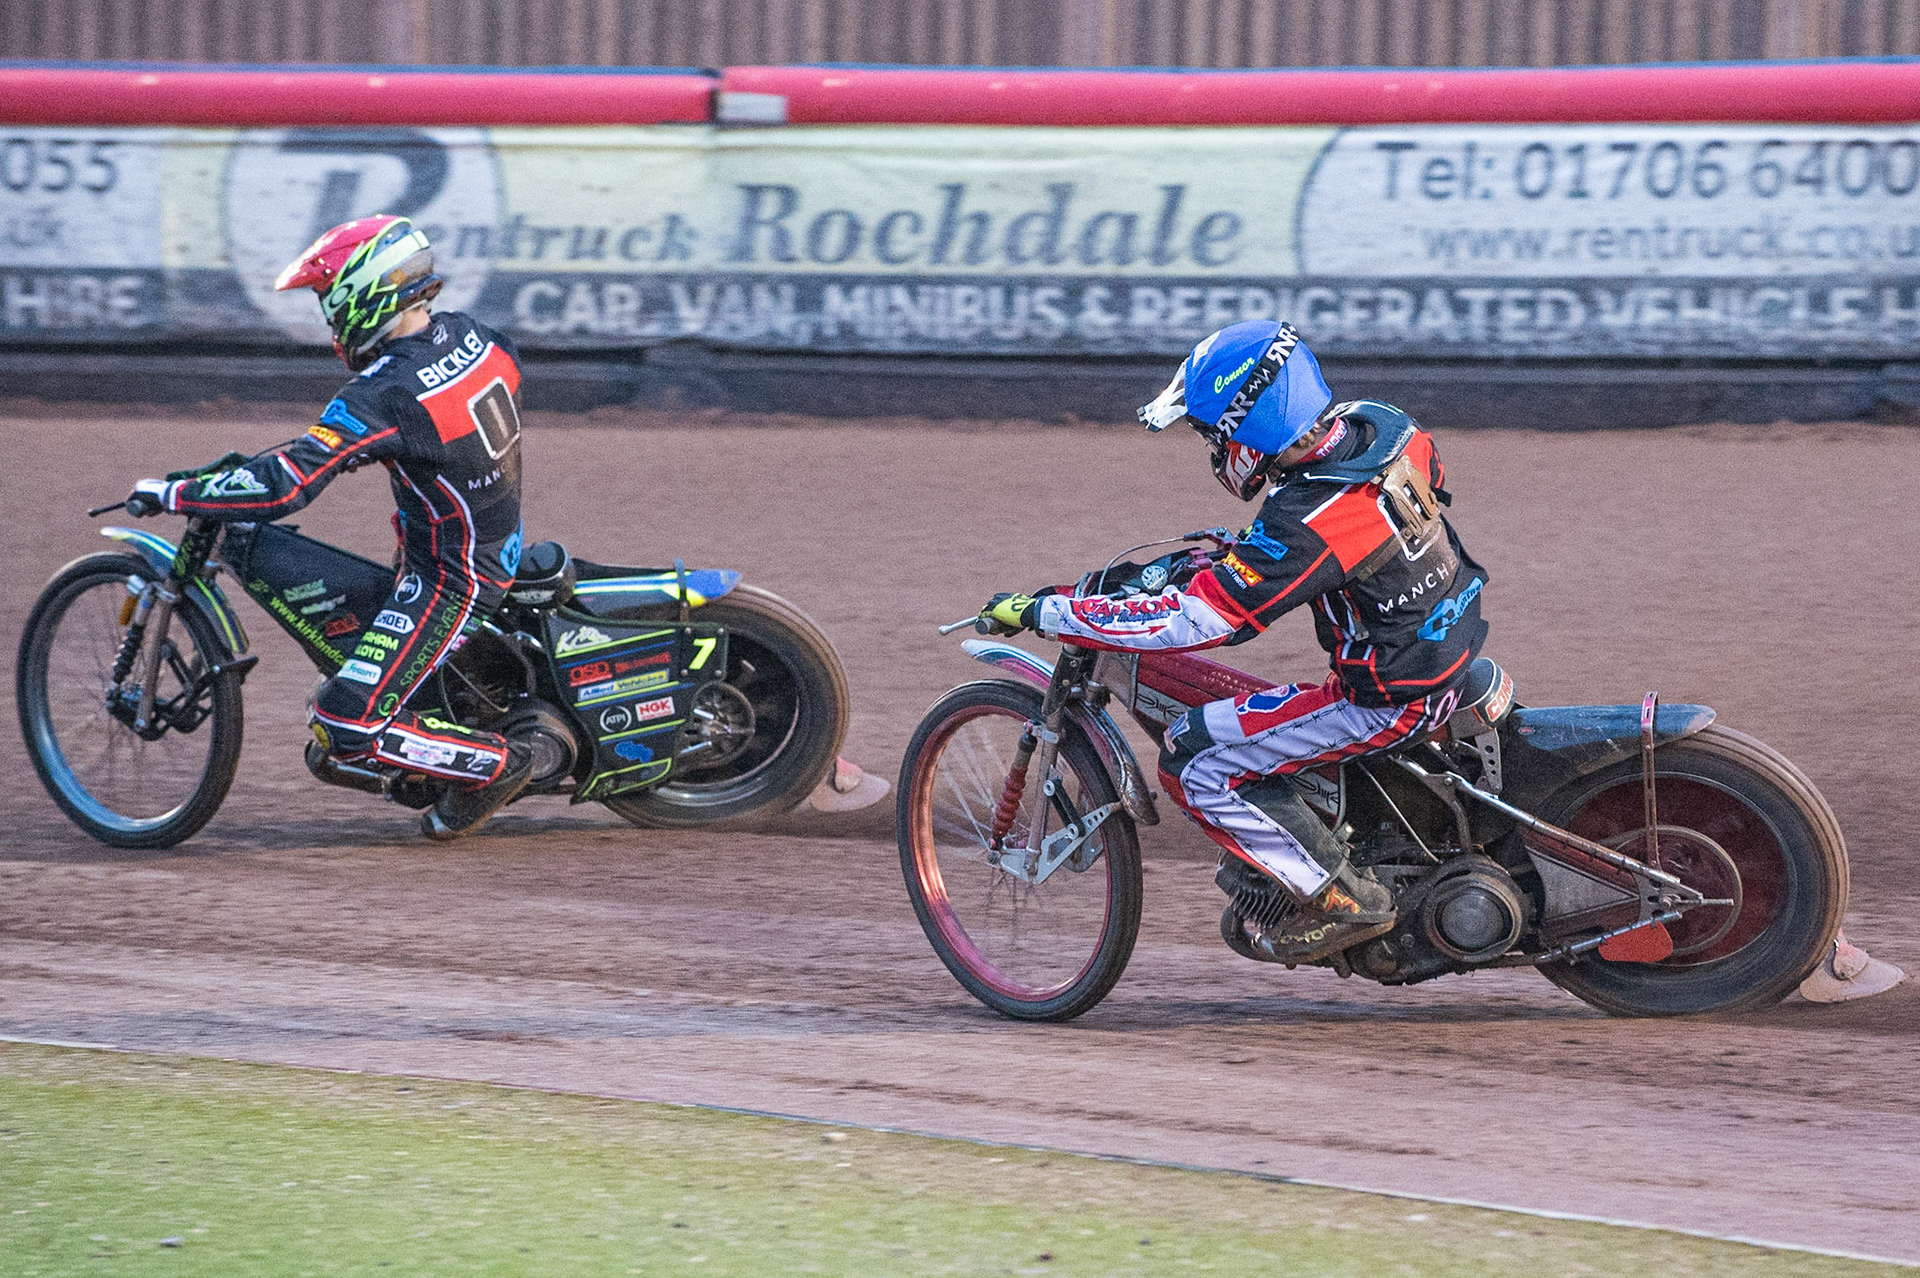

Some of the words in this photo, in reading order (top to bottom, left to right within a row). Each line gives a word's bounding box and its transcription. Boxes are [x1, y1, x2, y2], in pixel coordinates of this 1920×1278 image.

[1376, 141, 1495, 200] Tel:
[1514, 141, 1727, 201] 01706
[727, 182, 1244, 267] Rochdale
[822, 284, 1068, 340] MINIBUS
[416, 329, 485, 388] BICKLEY
[1214, 356, 1255, 394] Connor
[400, 639, 441, 687] SPORTS
[689, 638, 717, 669] 7
[639, 700, 671, 715] NGK
